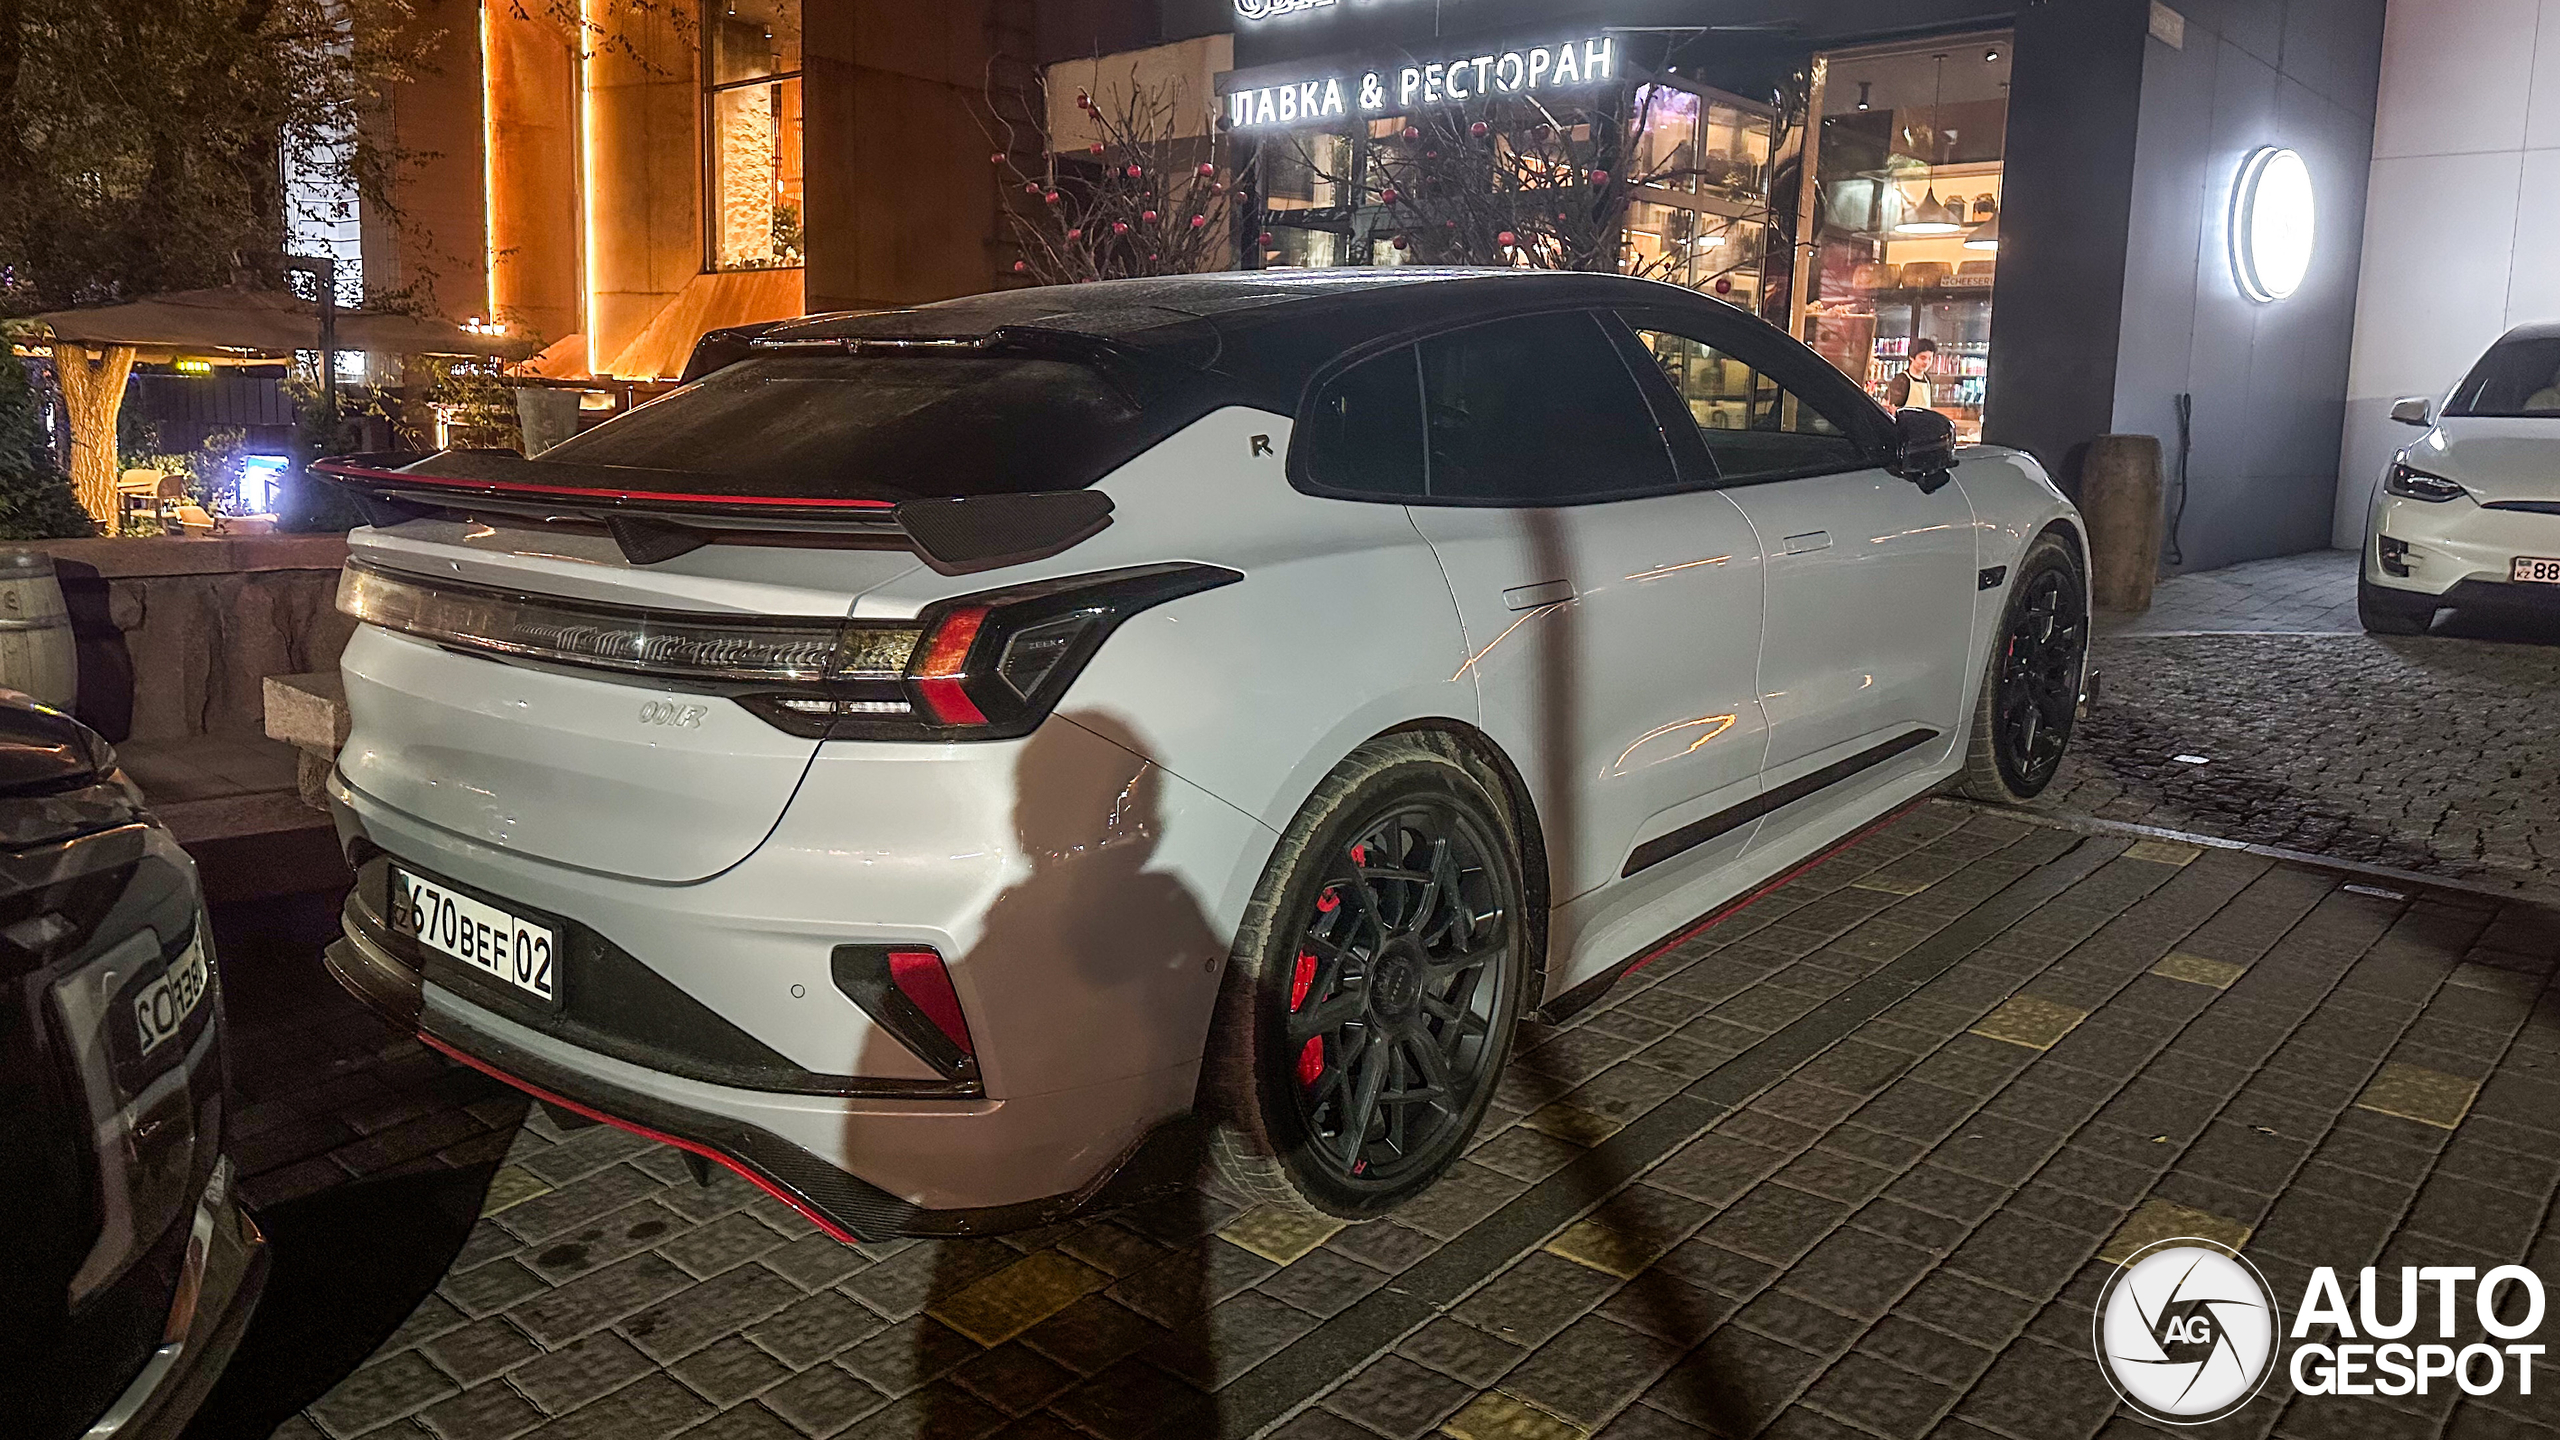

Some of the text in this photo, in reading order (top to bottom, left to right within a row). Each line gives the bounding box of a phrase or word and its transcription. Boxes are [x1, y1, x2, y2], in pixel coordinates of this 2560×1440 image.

[1231, 37, 1613, 127] ЛАВКА & РЕСТОРАН
[1250, 434, 1273, 457] R
